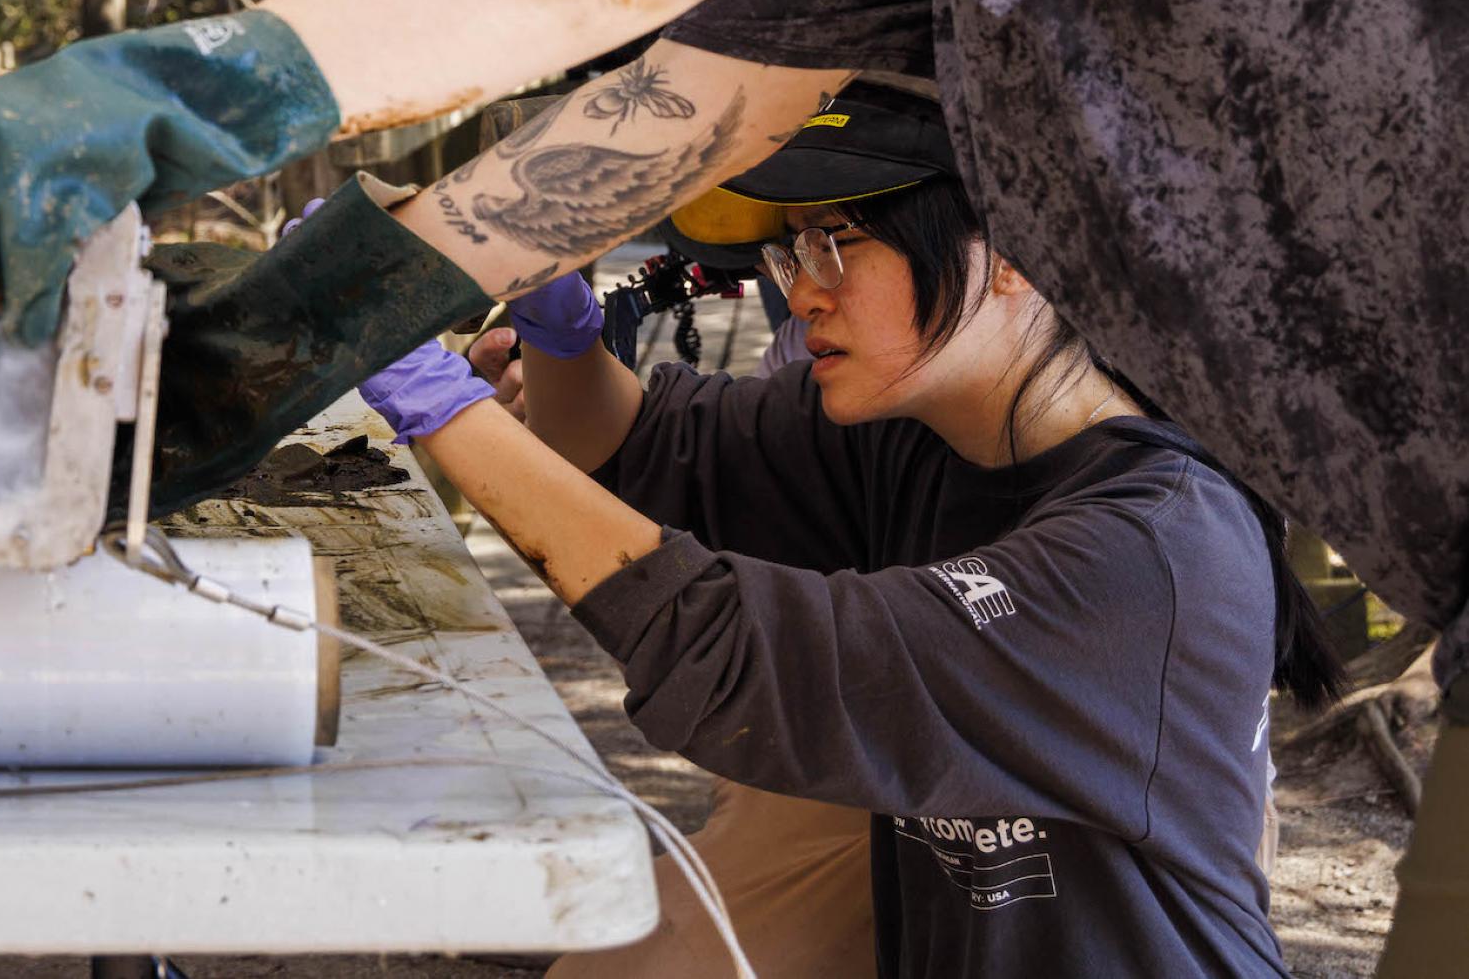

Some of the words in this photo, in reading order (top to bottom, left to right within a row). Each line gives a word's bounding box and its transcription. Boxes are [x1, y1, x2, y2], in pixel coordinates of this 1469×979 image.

[942, 556, 1016, 624] SAE
[930, 817, 1047, 853] comete.
[987, 890, 1010, 903] USA
